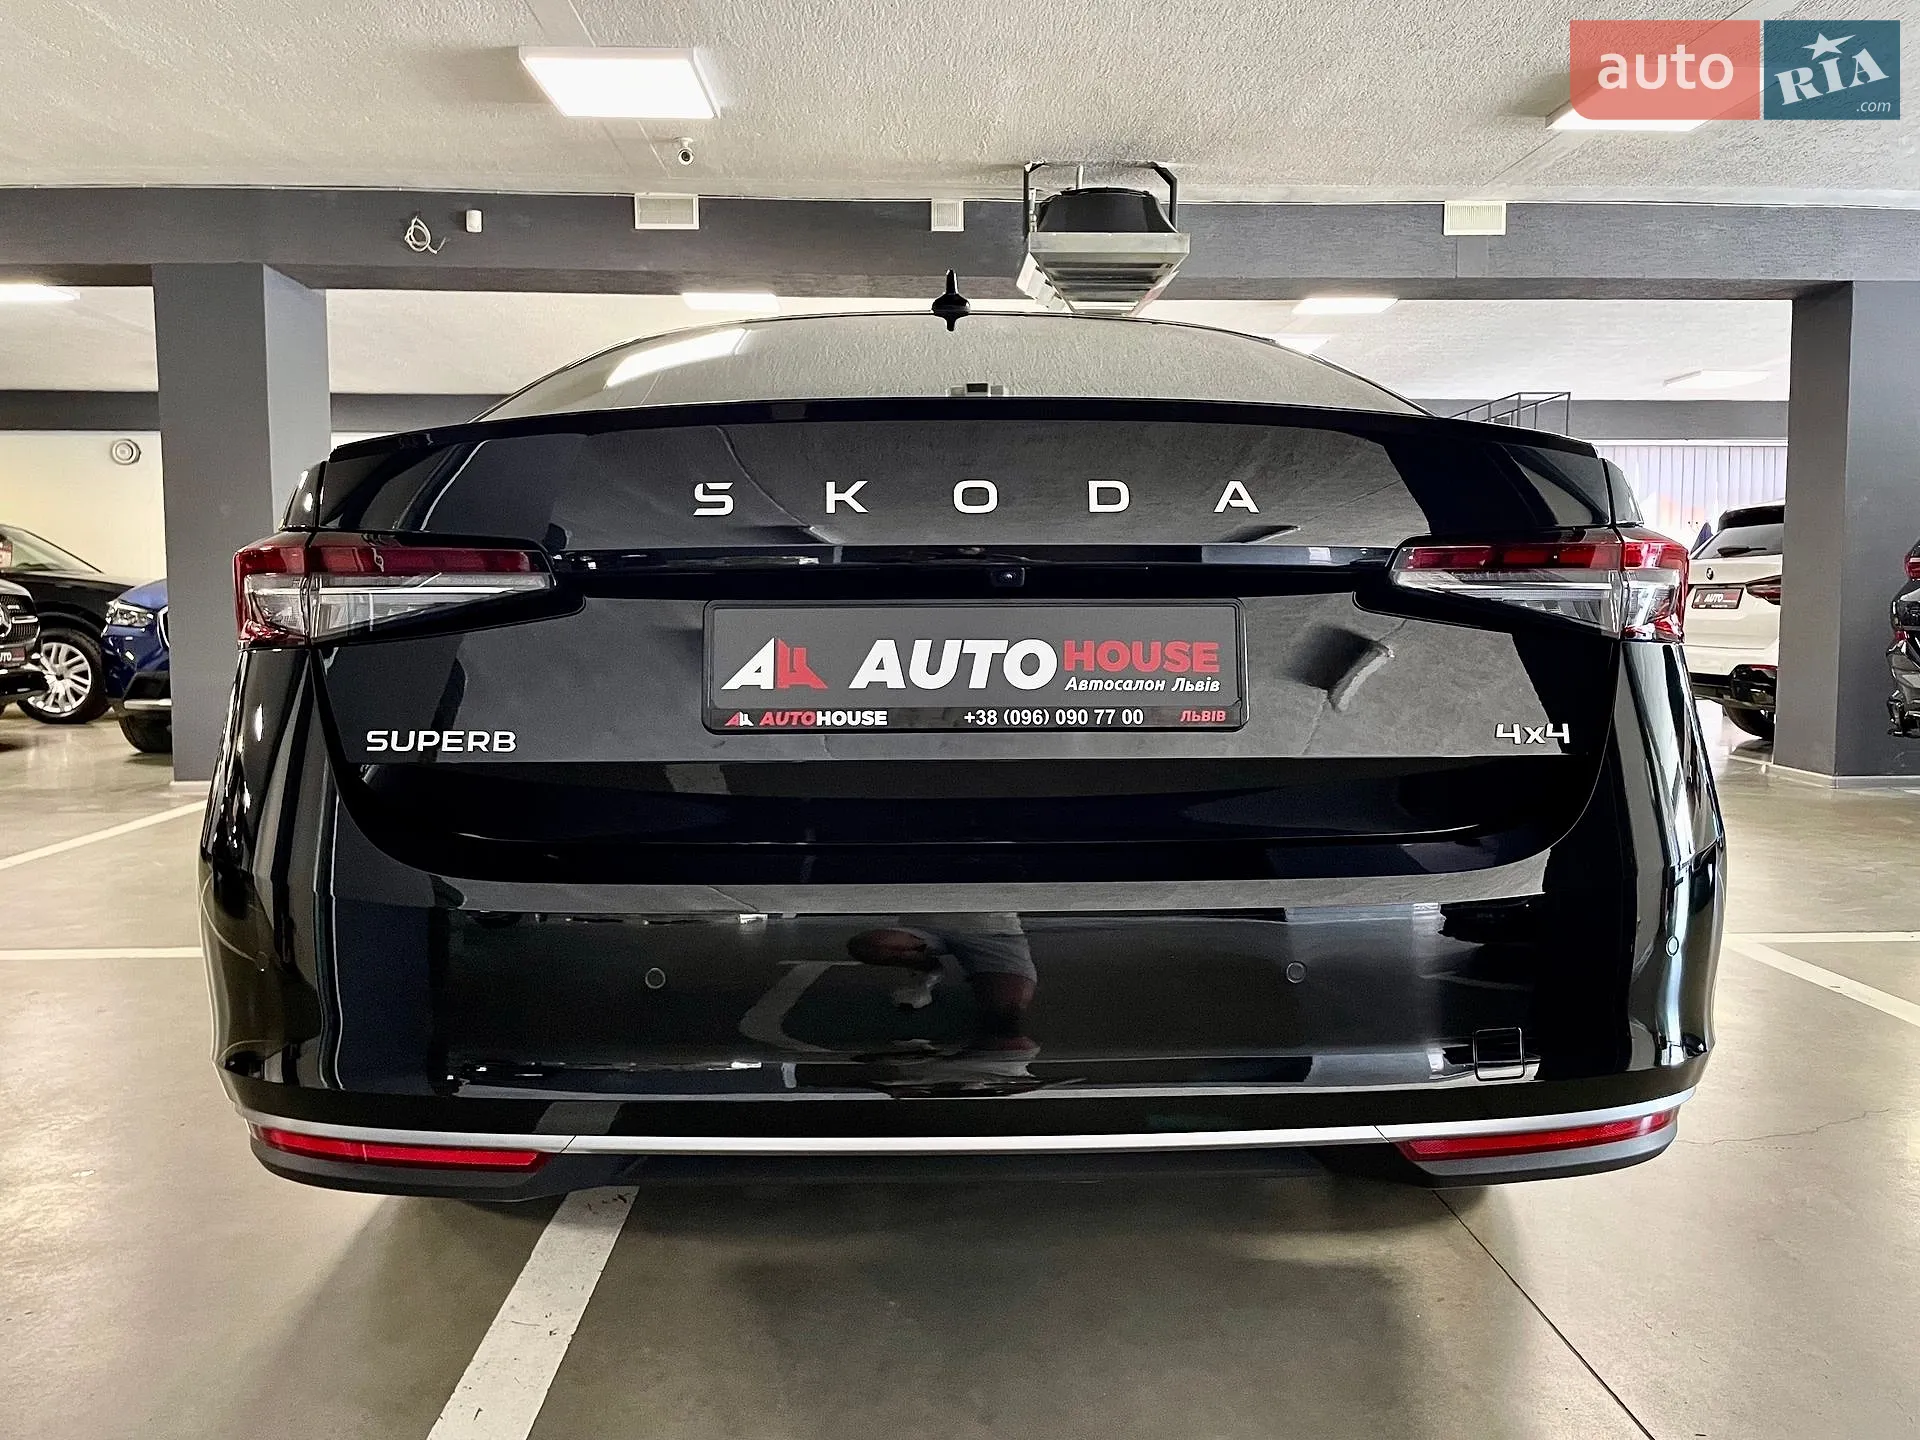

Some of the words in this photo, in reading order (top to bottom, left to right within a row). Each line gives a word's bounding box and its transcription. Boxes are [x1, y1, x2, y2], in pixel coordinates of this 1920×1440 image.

[848, 638, 1058, 690] AUTO
[1063, 639, 1221, 673] HOUSE
[1064, 676, 1166, 692] Автосалон
[1171, 677, 1221, 693] Львів
[759, 711, 888, 726] AUTOHOUSE
[963, 709, 998, 725] +38
[1003, 710, 1050, 726] (096)
[1055, 710, 1089, 725] 090
[1094, 709, 1116, 725] 77
[1121, 709, 1144, 725] 00
[366, 730, 518, 752] SUPERB
[1495, 723, 1571, 745] 4x4
